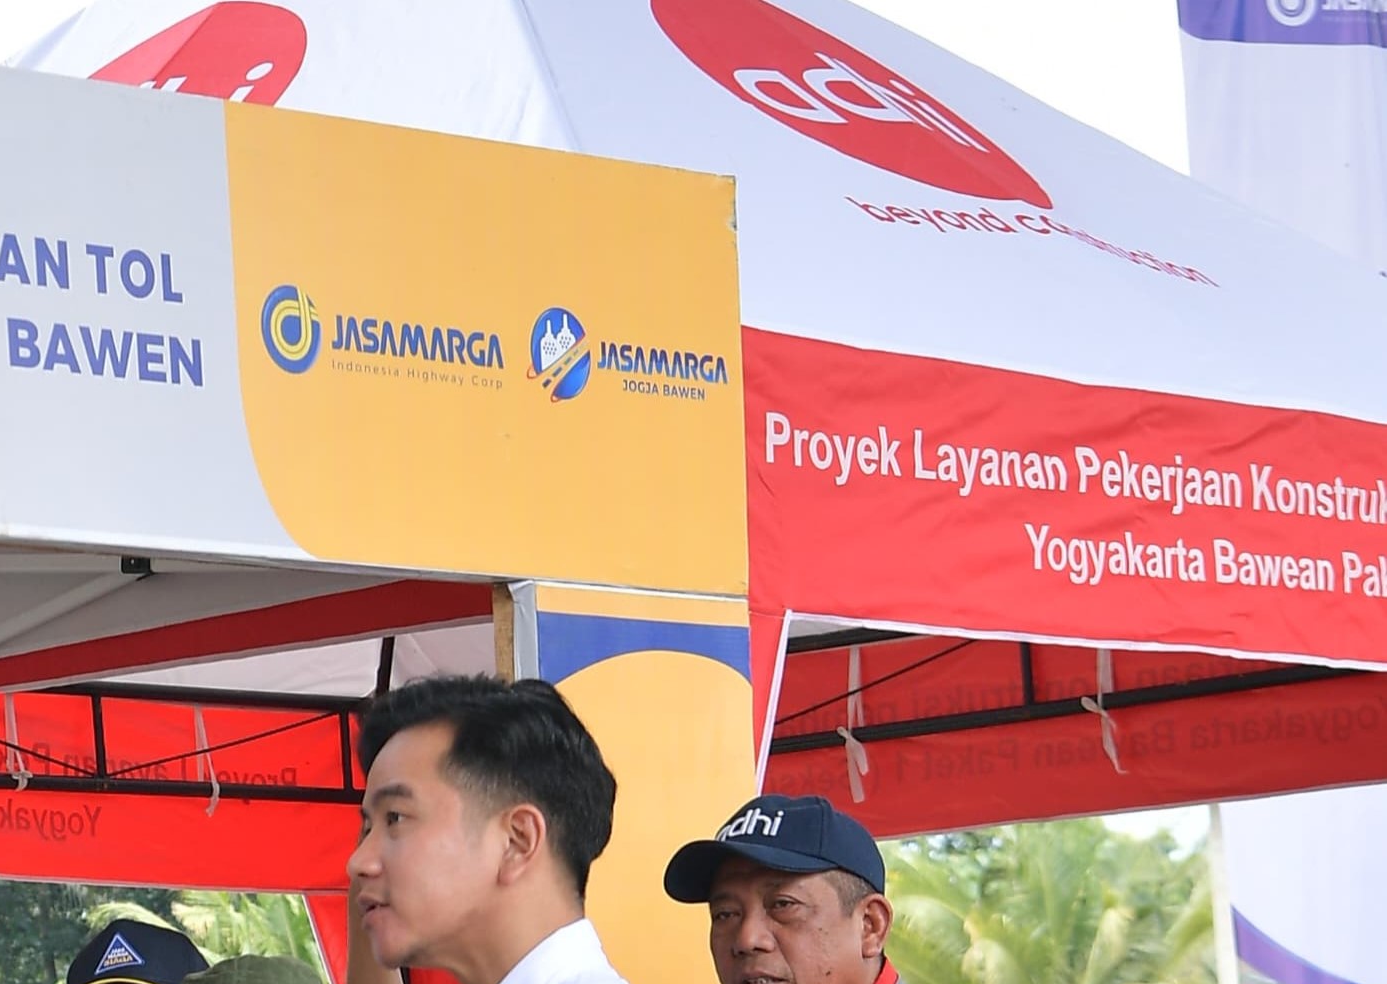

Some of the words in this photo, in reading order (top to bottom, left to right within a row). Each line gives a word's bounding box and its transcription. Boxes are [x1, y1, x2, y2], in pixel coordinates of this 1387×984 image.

[732, 51, 991, 153] adhi
[845, 196, 1018, 233] beyond
[86, 243, 183, 304] TOL
[8, 318, 204, 387] BAWEN
[331, 314, 505, 369] JASAMARGA
[597, 341, 728, 384] JASAMARGA
[331, 359, 400, 377] Indonesia
[407, 368, 465, 386] Highway
[471, 375, 503, 390] Corp
[623, 379, 659, 396] JOGJA
[663, 384, 705, 400] BAWEN
[765, 411, 901, 487] Proyek
[913, 428, 1066, 496] Layanan
[1076, 445, 1242, 515] Pekerjaan
[1024, 523, 1205, 586] Yogyakarta
[1214, 537, 1334, 592] Bawean
